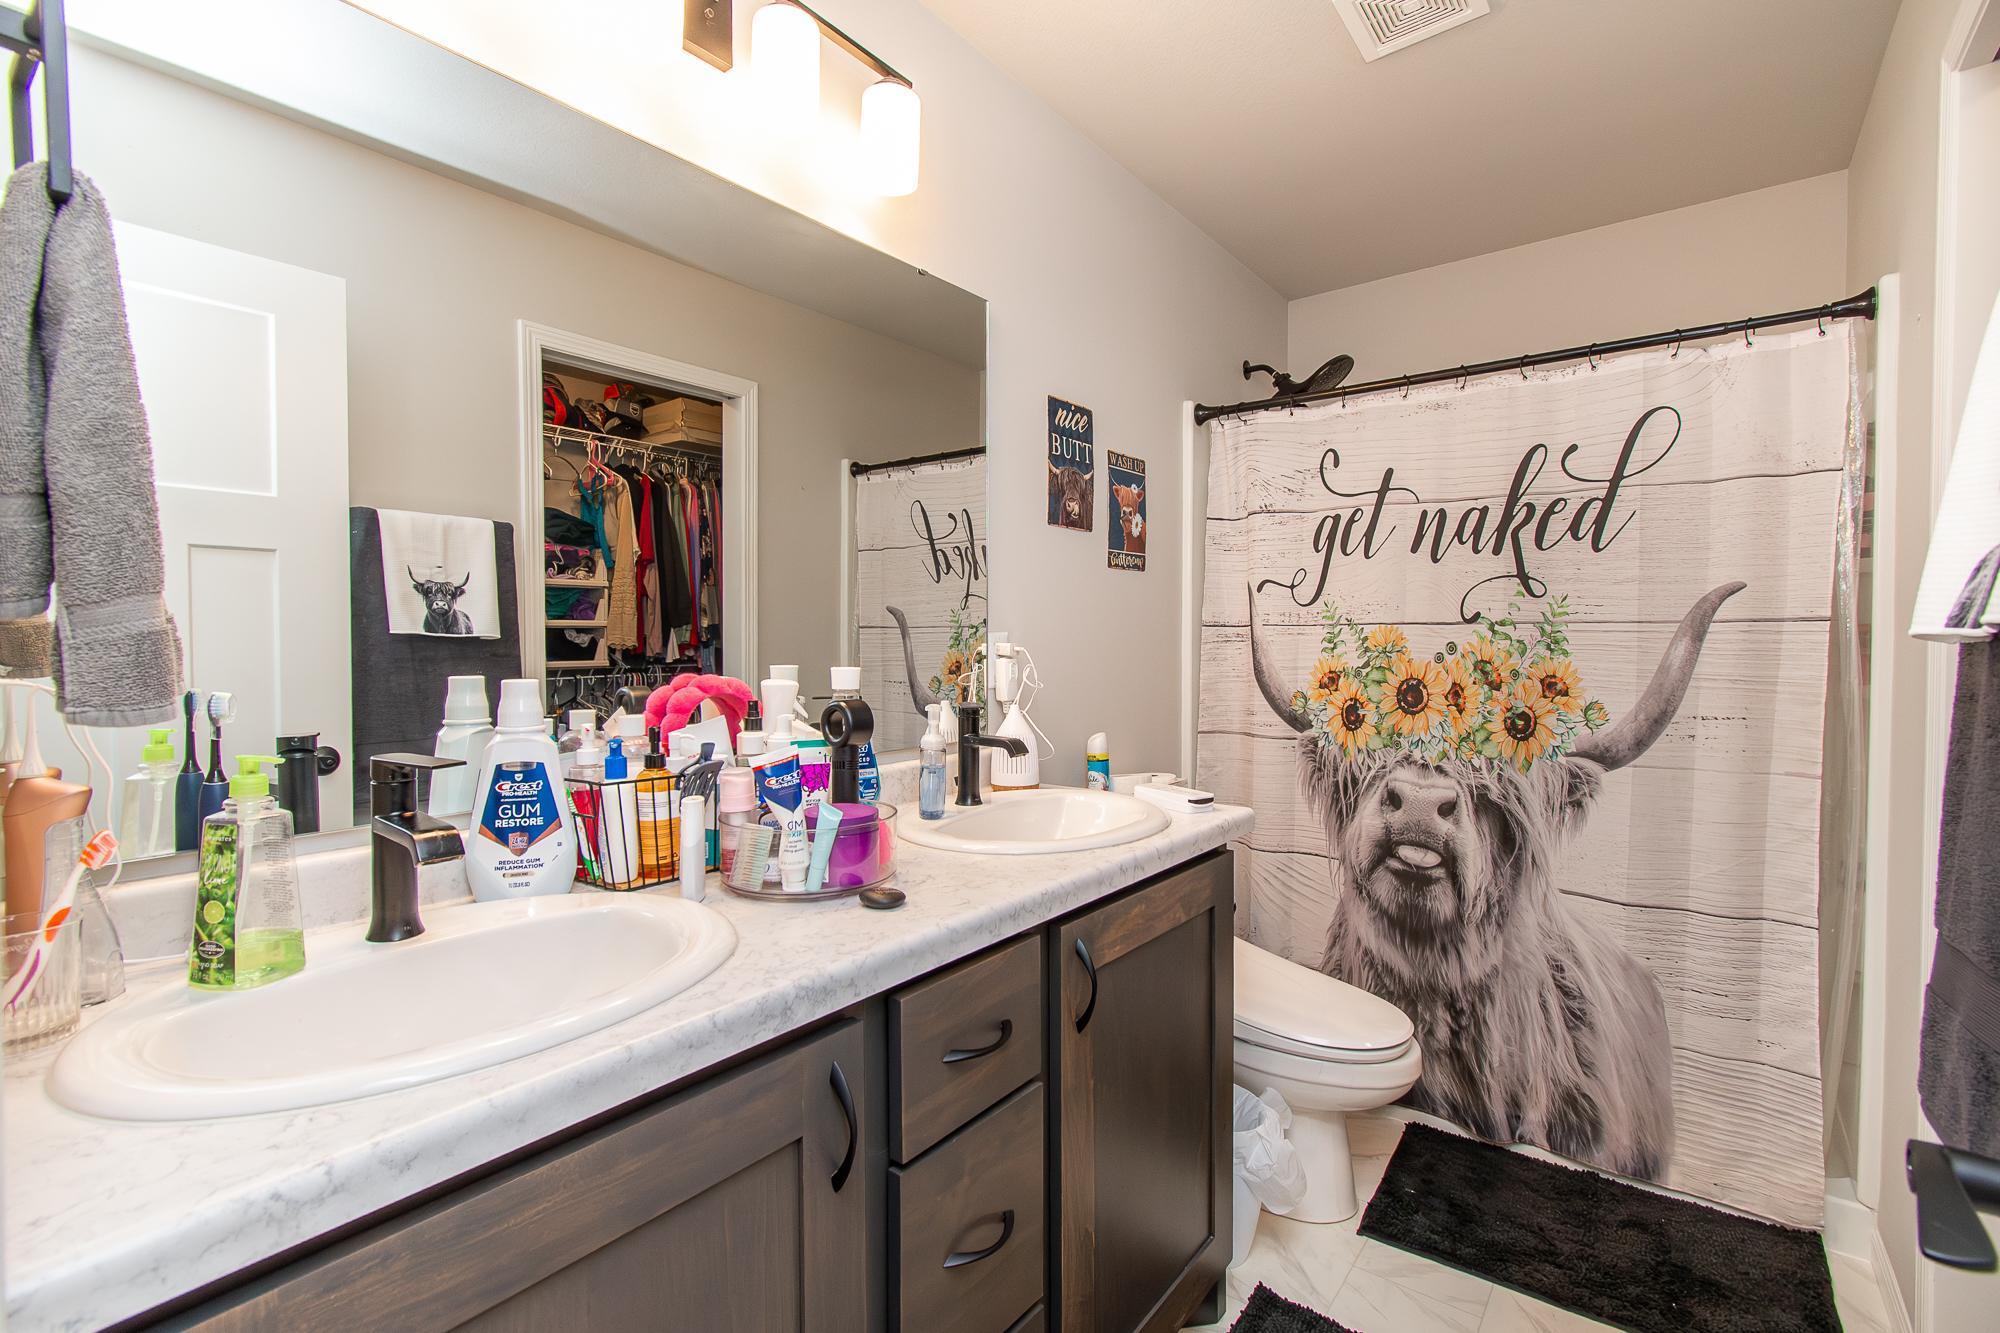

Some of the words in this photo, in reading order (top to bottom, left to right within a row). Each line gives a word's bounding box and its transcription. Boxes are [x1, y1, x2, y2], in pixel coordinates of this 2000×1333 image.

[1055, 405, 1089, 432] nice
[1051, 433, 1092, 463] BUTT
[1110, 453, 1133, 470] WASH
[1134, 460, 1145, 472] UP
[1258, 448, 1420, 607] get
[1410, 406, 1681, 624] naked
[495, 780, 543, 791] Crest
[764, 769, 801, 788] Crest
[498, 803, 541, 818] GUM
[495, 817, 544, 828] RESTORE
